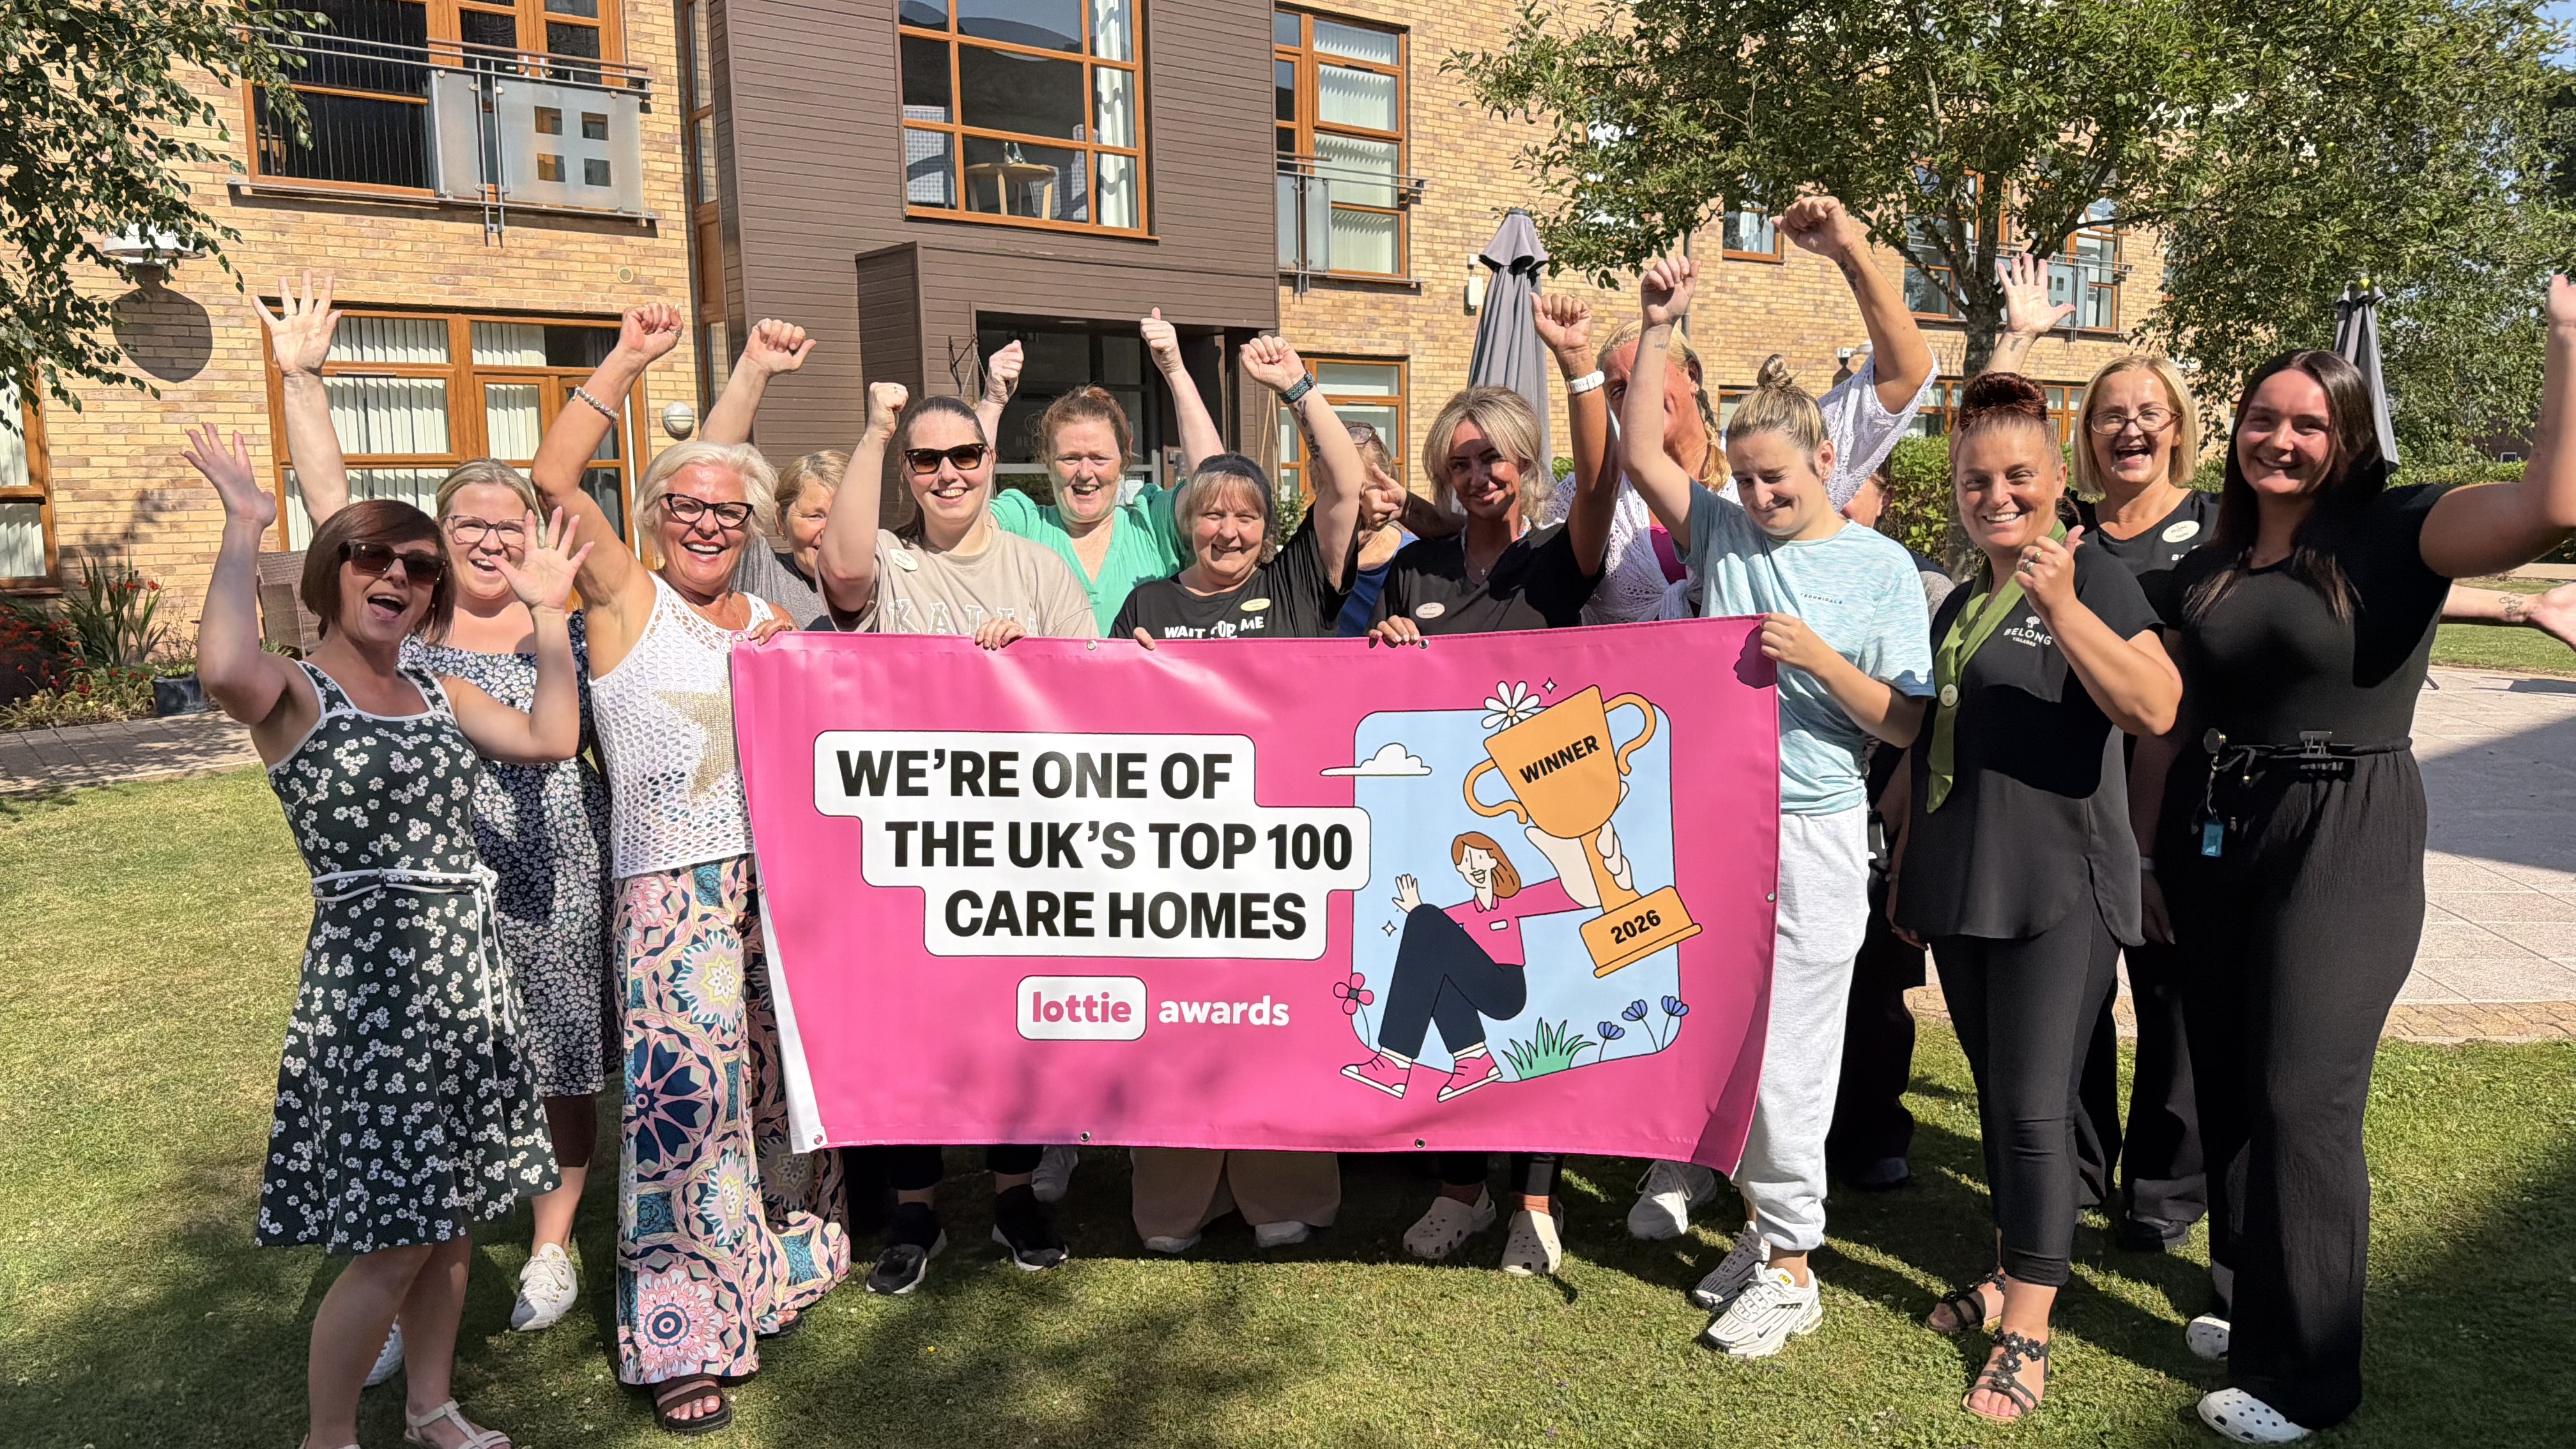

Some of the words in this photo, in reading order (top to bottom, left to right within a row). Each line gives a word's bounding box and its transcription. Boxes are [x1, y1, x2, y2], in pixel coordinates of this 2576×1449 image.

[1164, 625, 1206, 639] WAIT
[1240, 616, 1264, 631] ME
[2004, 627, 2052, 645] BELONG
[836, 748, 1020, 797] WE’RE
[1032, 751, 1147, 799] ONE
[1160, 752, 1232, 799] OF
[1519, 735, 1600, 784] WINNER
[885, 821, 995, 868] THE
[1008, 820, 1135, 870] UK’S
[1149, 822, 1257, 870] TOP
[1267, 824, 1353, 871] 100
[945, 889, 1095, 937] CARE
[1108, 891, 1307, 940] HOMES
[1611, 908, 1661, 945] 2026
[1032, 992, 1131, 1023] lottie
[1158, 995, 1289, 1026] awards
